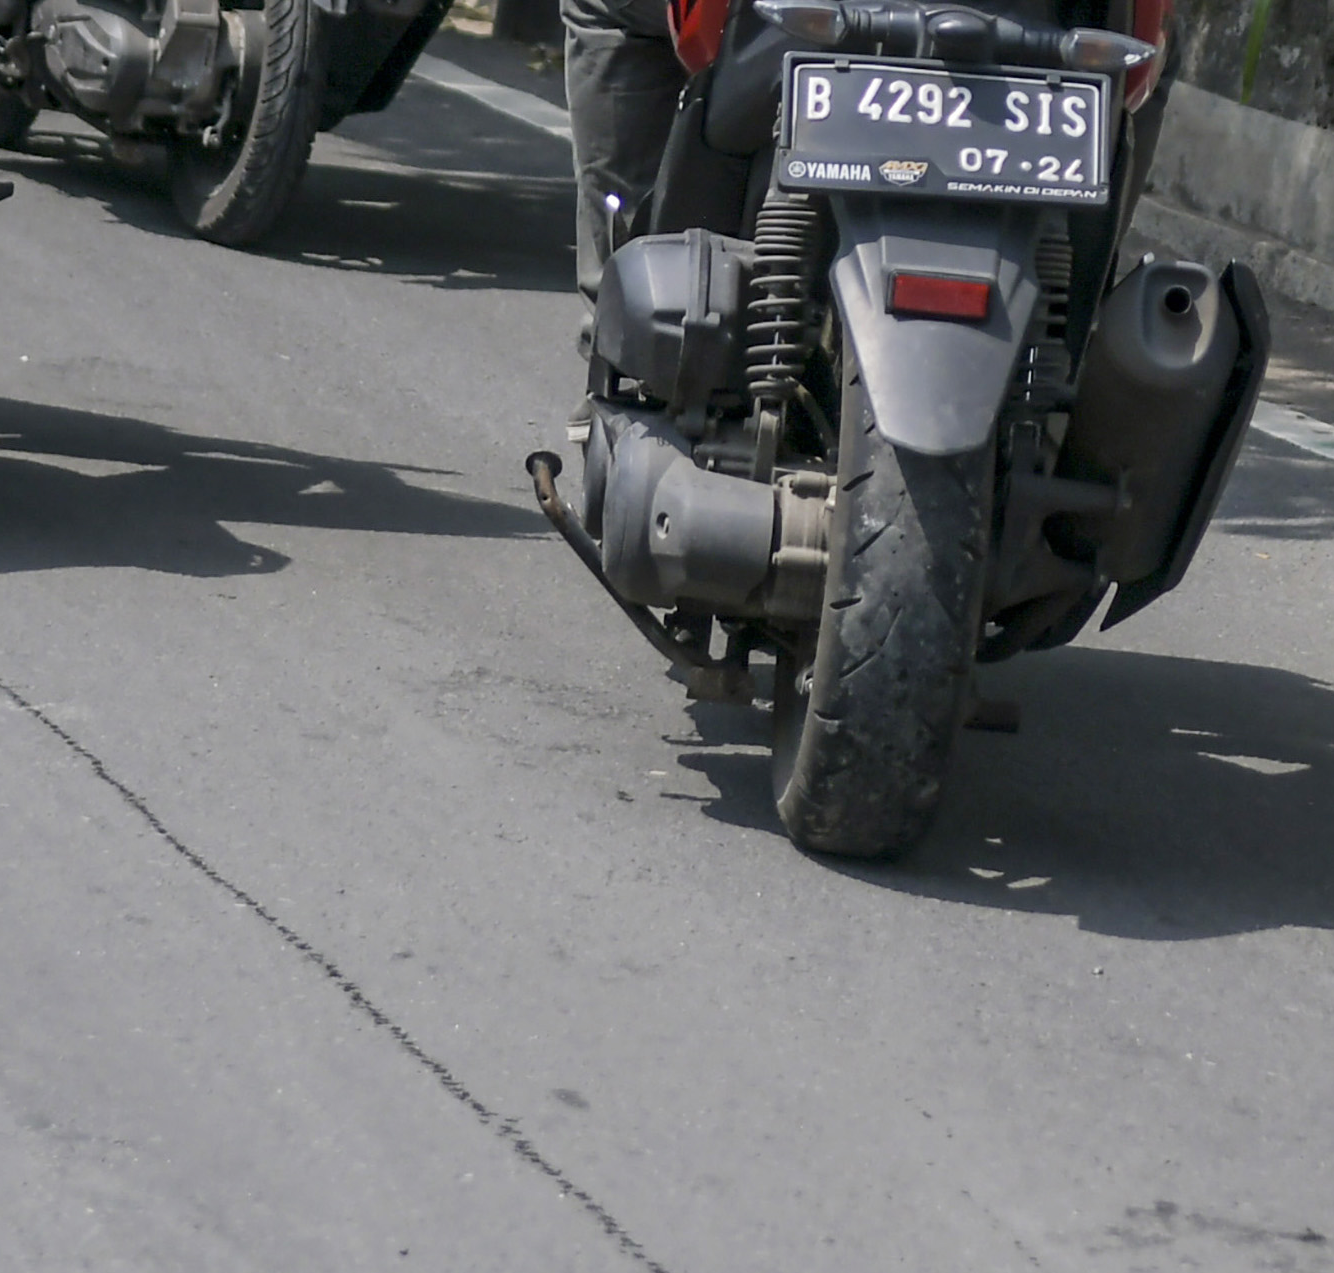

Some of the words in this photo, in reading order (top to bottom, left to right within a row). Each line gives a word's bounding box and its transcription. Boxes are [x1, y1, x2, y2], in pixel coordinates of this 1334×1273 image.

[807, 76, 832, 120] B
[858, 78, 973, 128] 4292
[1005, 91, 1087, 138] SIS
[807, 162, 872, 181] YAMAHA
[947, 181, 1022, 195] SEMAKIN
[1023, 186, 1040, 195] DI
[1041, 187, 1098, 198] DEPAN
